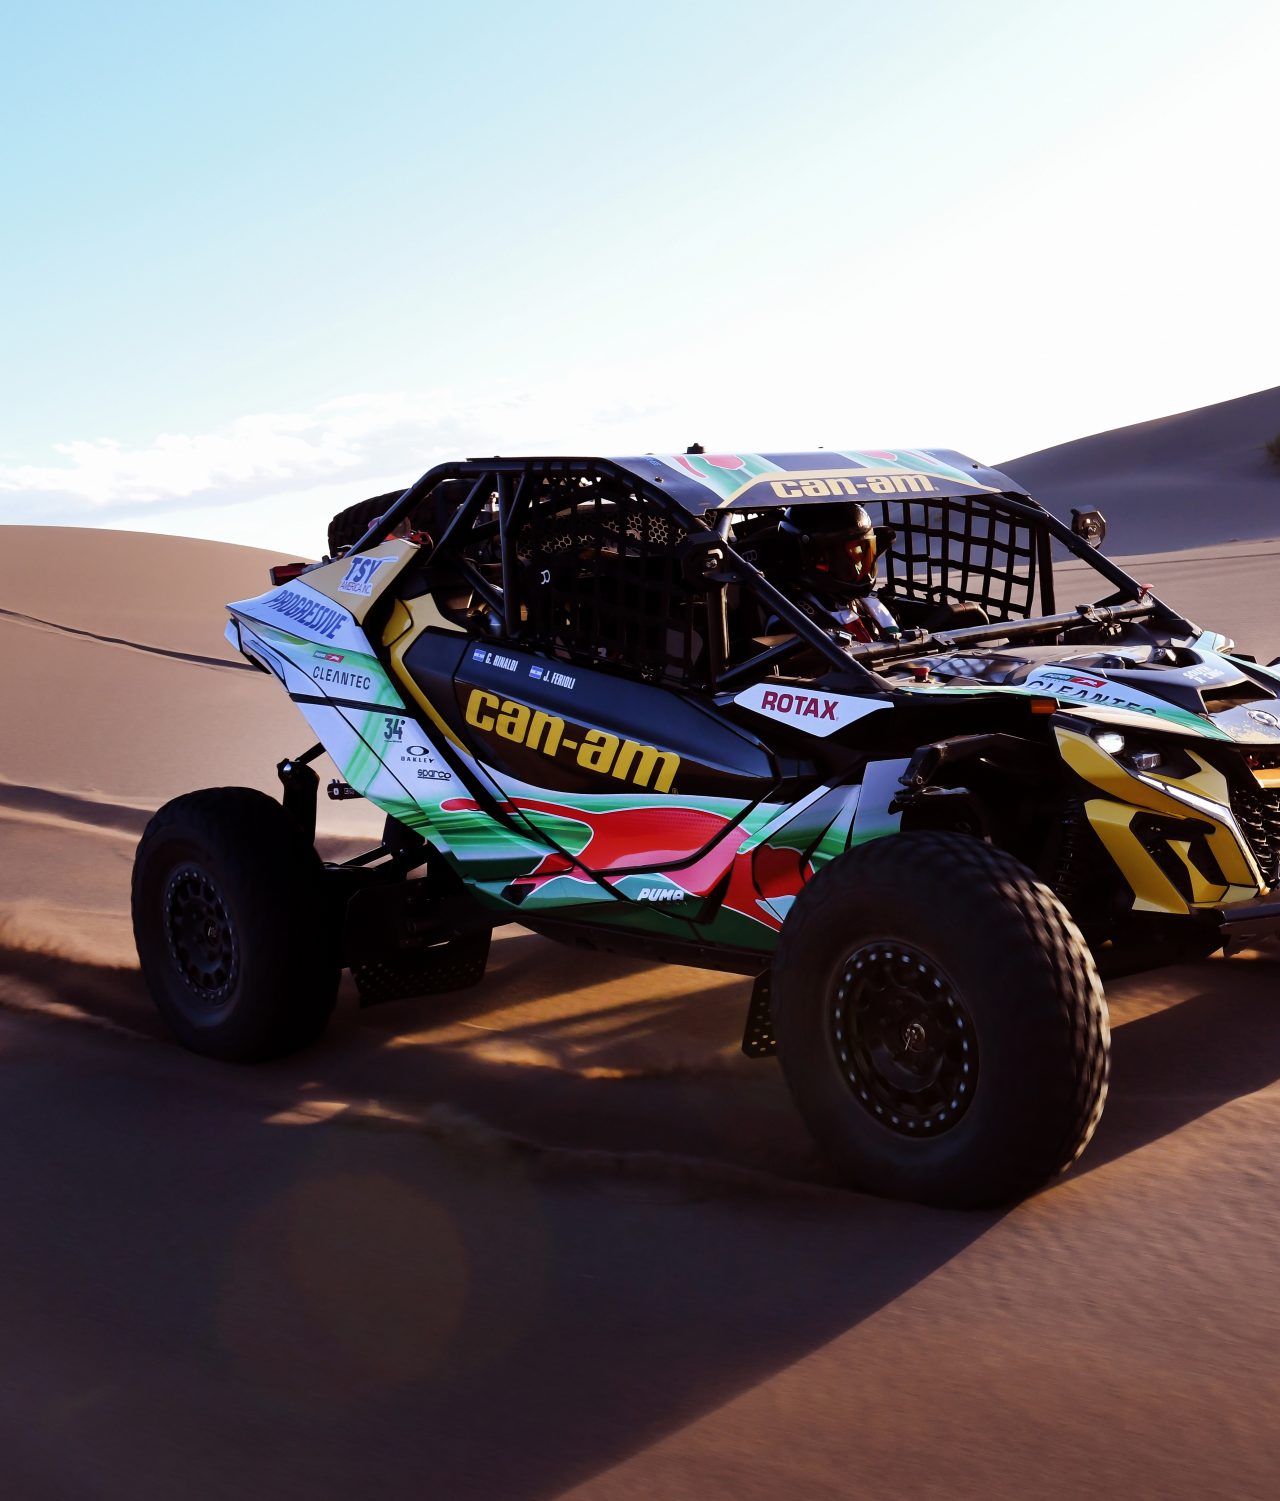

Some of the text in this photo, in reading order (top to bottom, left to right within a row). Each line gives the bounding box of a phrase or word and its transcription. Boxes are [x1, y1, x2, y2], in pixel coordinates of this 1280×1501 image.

[770, 474, 936, 499] can-am
[345, 557, 385, 583] TSY
[262, 589, 347, 639] PROGRESSIVE
[493, 655, 519, 672] RINALDI
[312, 665, 371, 690] CLEANTEC
[543, 670, 576, 689] J. FERIOLI
[761, 690, 839, 721] ROTAX
[465, 688, 681, 794] can-am
[417, 769, 452, 780] sparco
[637, 888, 685, 902] PUMA
